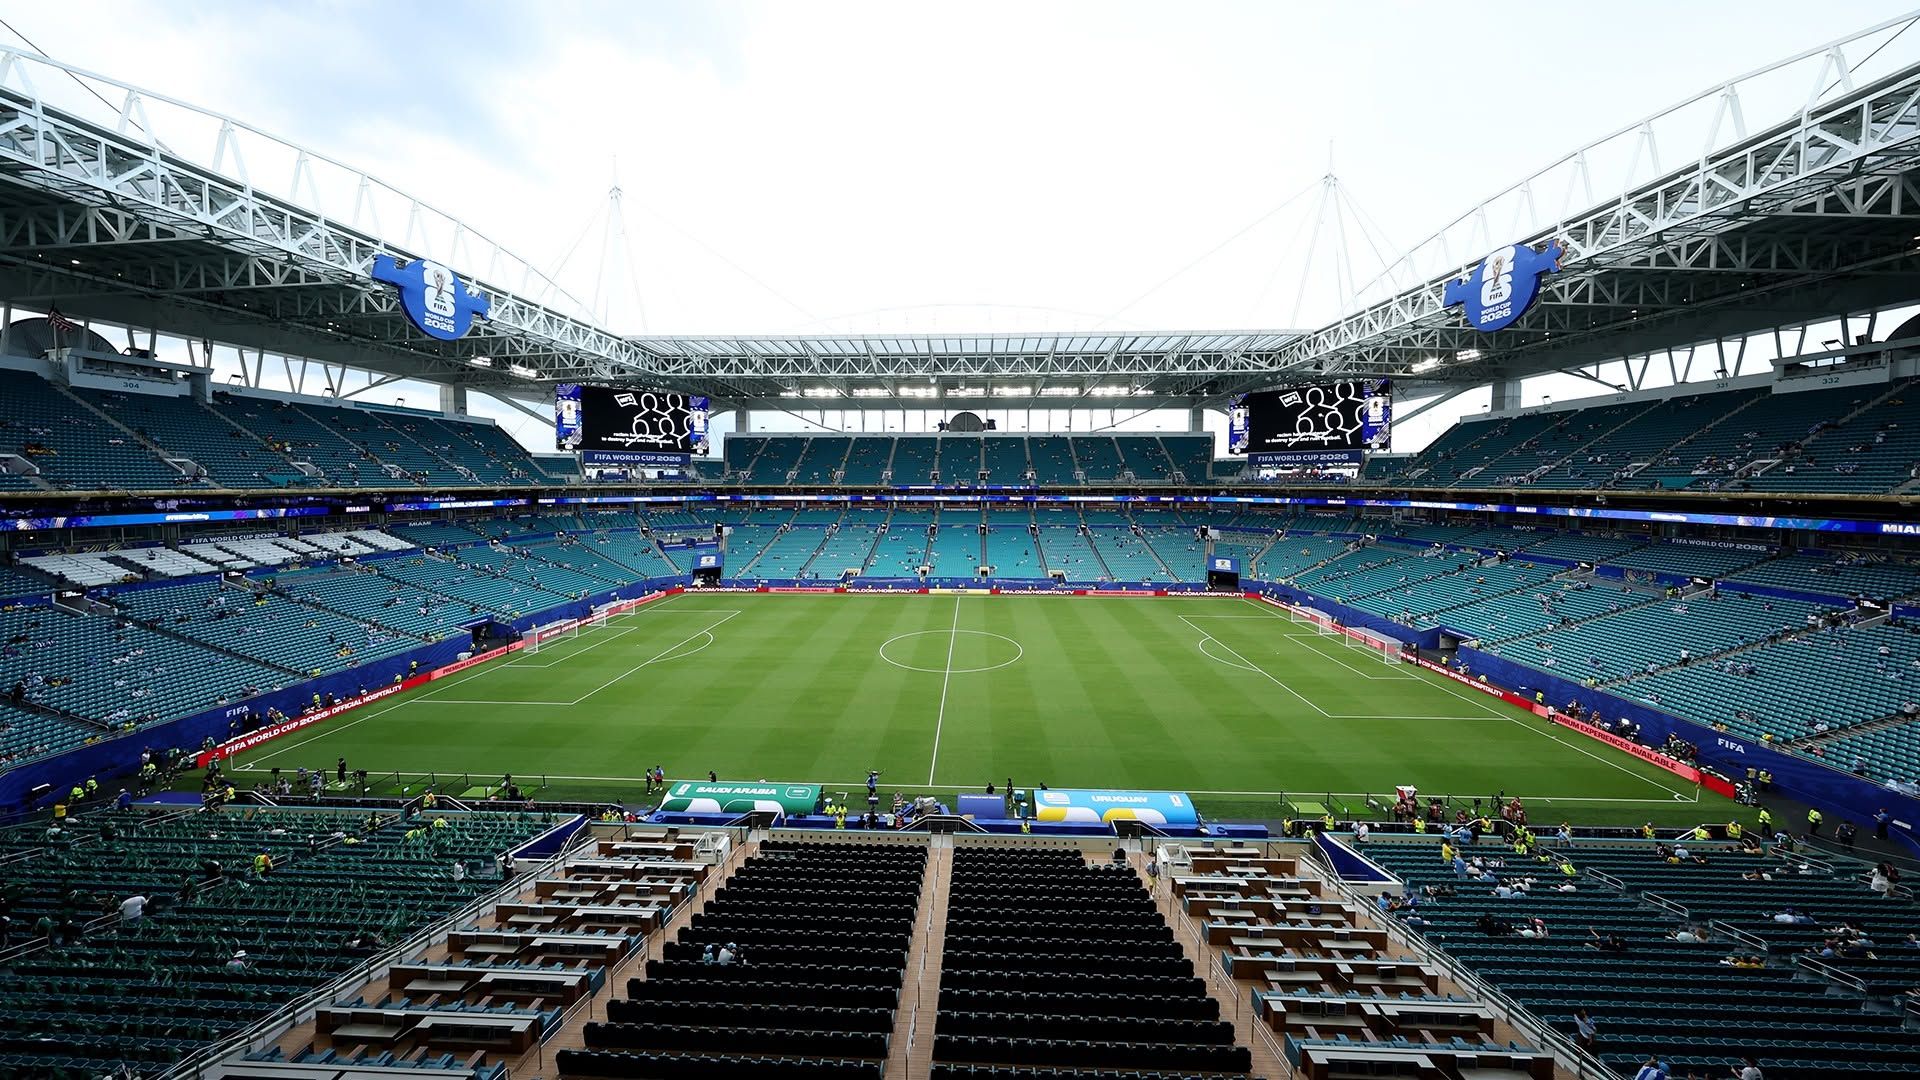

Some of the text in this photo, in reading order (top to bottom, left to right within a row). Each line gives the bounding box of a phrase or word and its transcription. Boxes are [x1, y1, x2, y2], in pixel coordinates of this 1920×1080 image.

[1489, 291, 1504, 301] FIFA
[433, 302, 448, 311] FIFA
[1480, 307, 1512, 325] 2026
[424, 317, 455, 333] 2026
[1671, 537, 1768, 551] FIFA WORLD CUP 2026
[442, 662, 466, 674] PREMIUM
[466, 652, 495, 666] EXPERIENCES
[1448, 671, 1470, 685] OFFICIAL
[1469, 679, 1504, 697] HOSPITALITY
[225, 684, 403, 755] FIFA WORLD CUP 2026: OFFICIAL HOSPITALITY
[226, 705, 249, 718] FIFA
[1554, 715, 1677, 772] EMIUM EXPERIENCES AVAILABLE
[1717, 737, 1745, 754] FIFA
[696, 786, 777, 795] SAUDI ARABIA
[1091, 795, 1148, 803] URUGUAY
